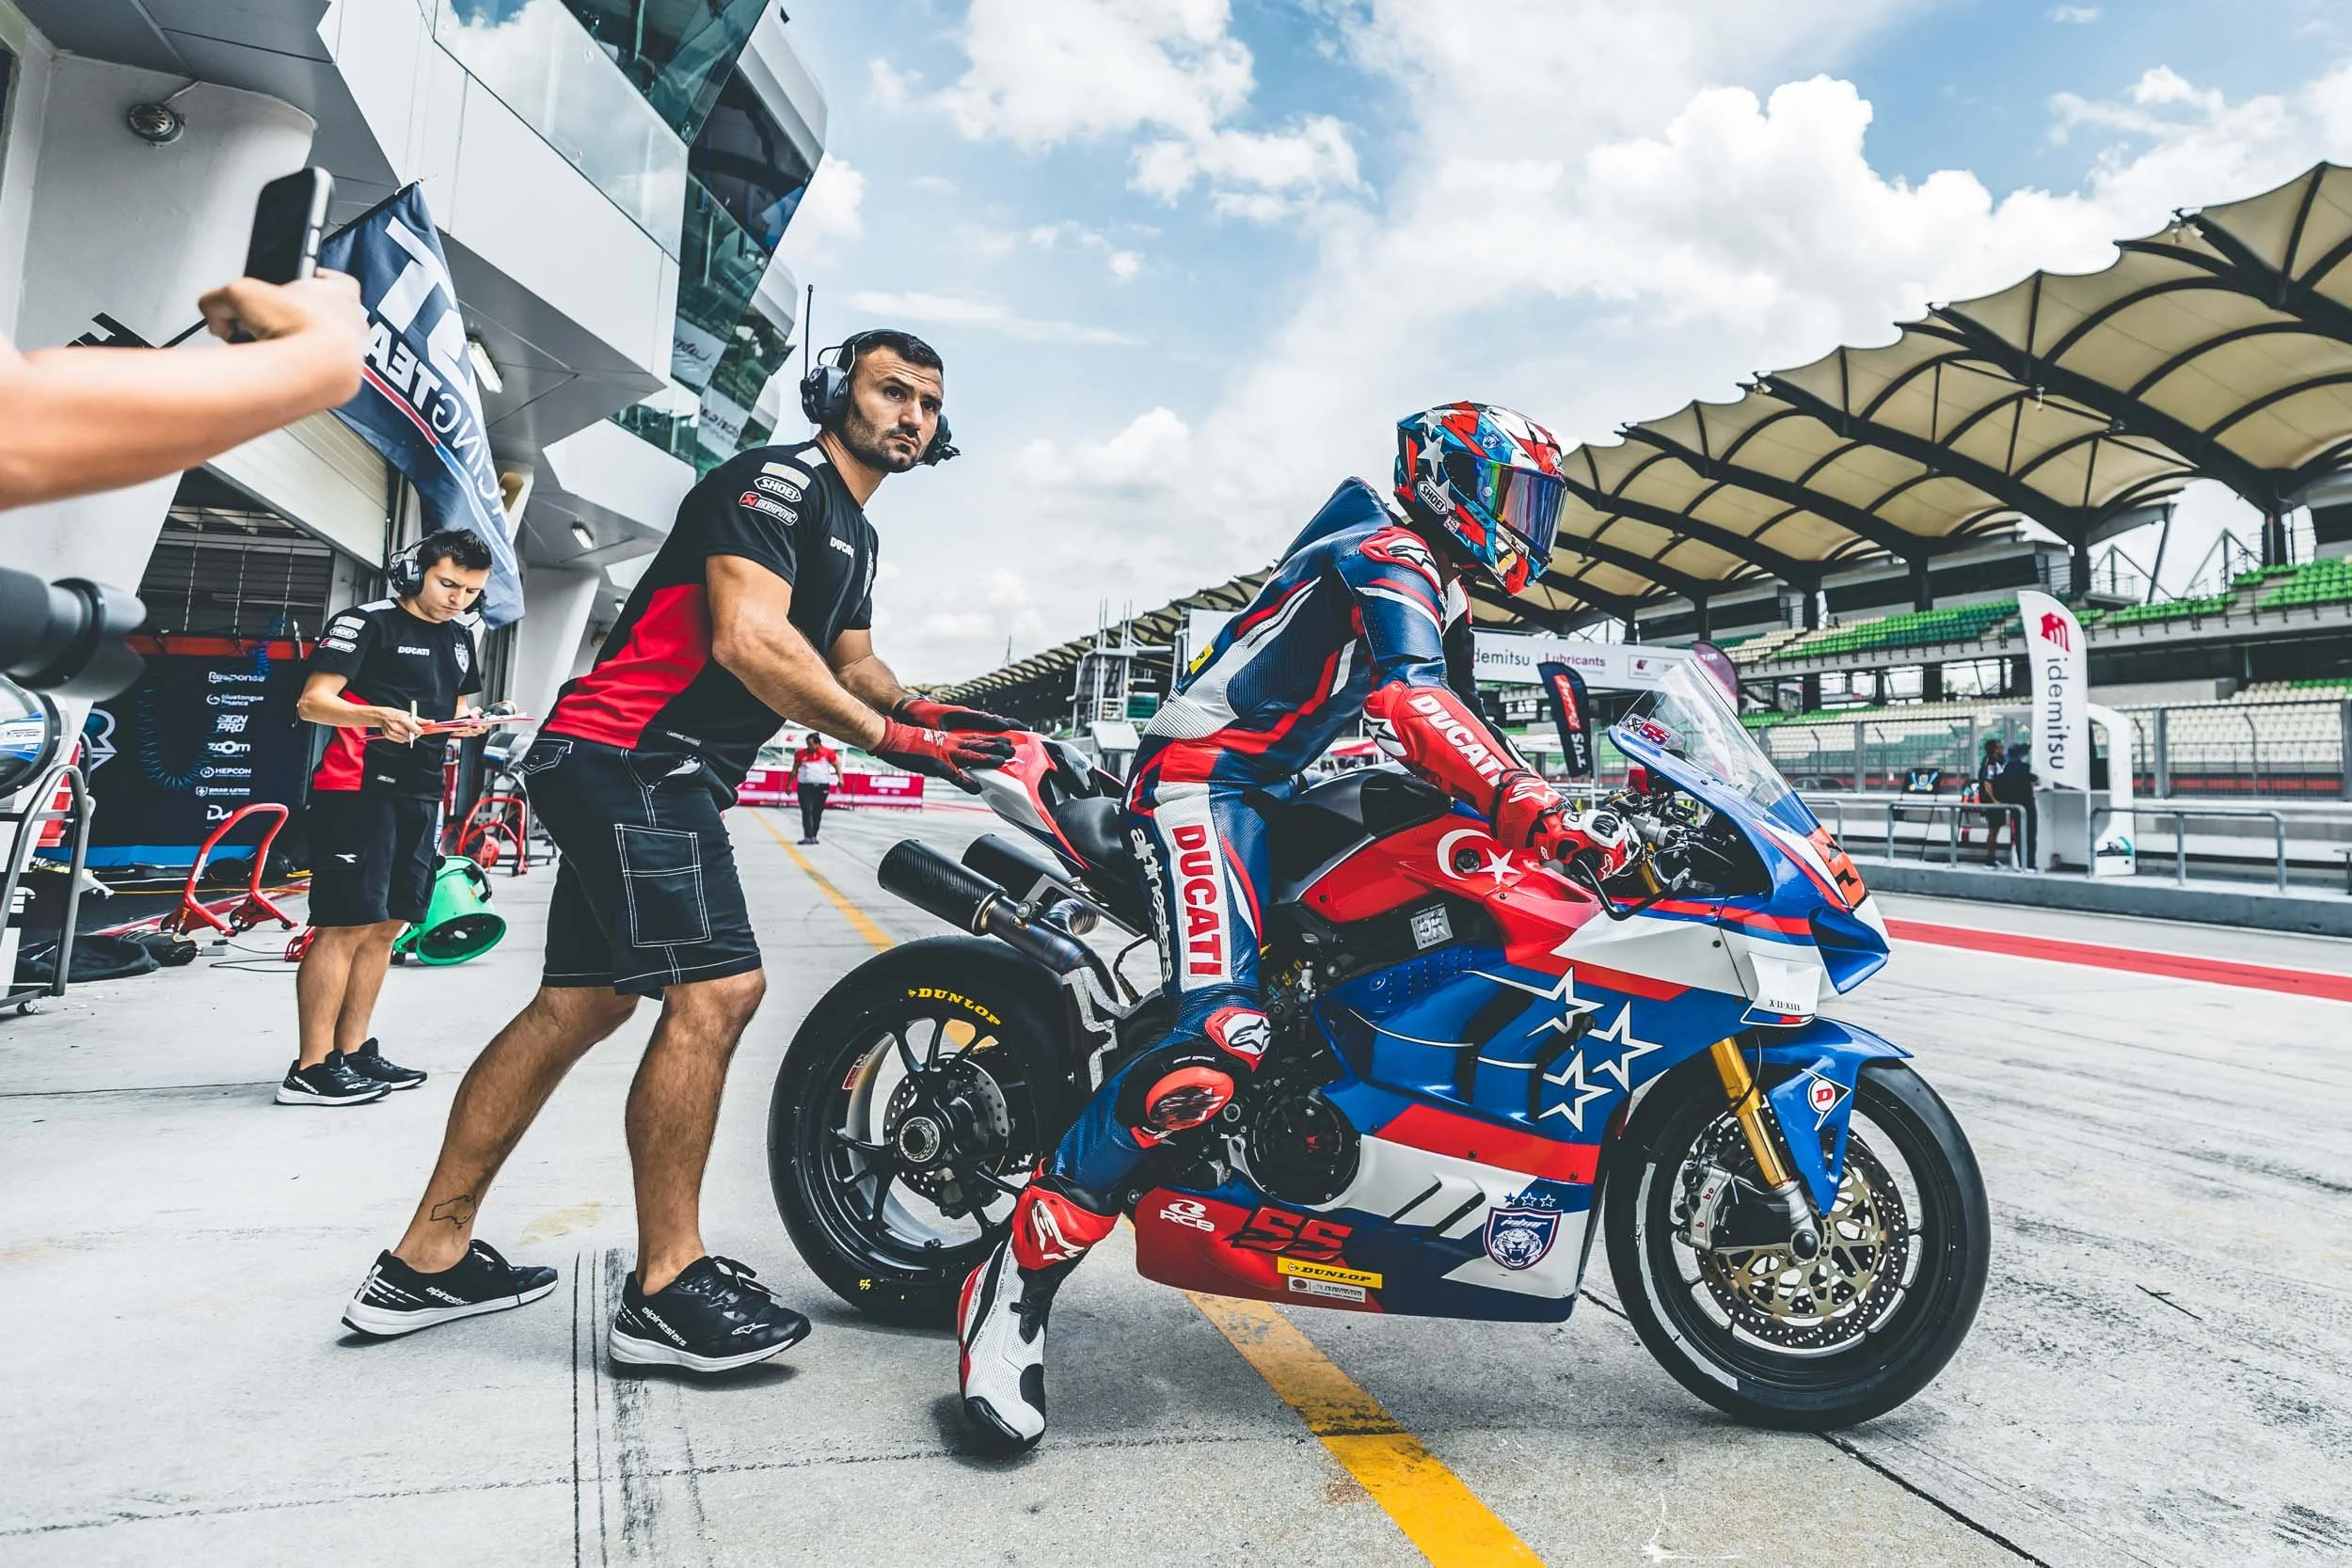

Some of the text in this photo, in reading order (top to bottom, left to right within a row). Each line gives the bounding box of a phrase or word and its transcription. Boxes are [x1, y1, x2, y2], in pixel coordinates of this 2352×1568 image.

[760, 478, 796, 499] SHOEI
[1421, 485, 1445, 511] SHOEI
[397, 646, 430, 657] DUCATI
[1474, 647, 1606, 667] demitsu Lubricants
[216, 715, 249, 723] SIGN
[2047, 657, 2071, 770] idemitsu
[215, 722, 246, 733] PRO
[1640, 722, 1671, 746] 55
[1571, 733, 1586, 768] TVS
[1130, 828, 1173, 983] alpinestars
[1171, 824, 1222, 975] DUCATI
[918, 988, 1002, 1025] DUNLOP
[1816, 1087, 1834, 1103] D
[1159, 1208, 1216, 1233] RCB
[1301, 1266, 1372, 1282] DUNLOP
[642, 1307, 688, 1347] alpinestars
